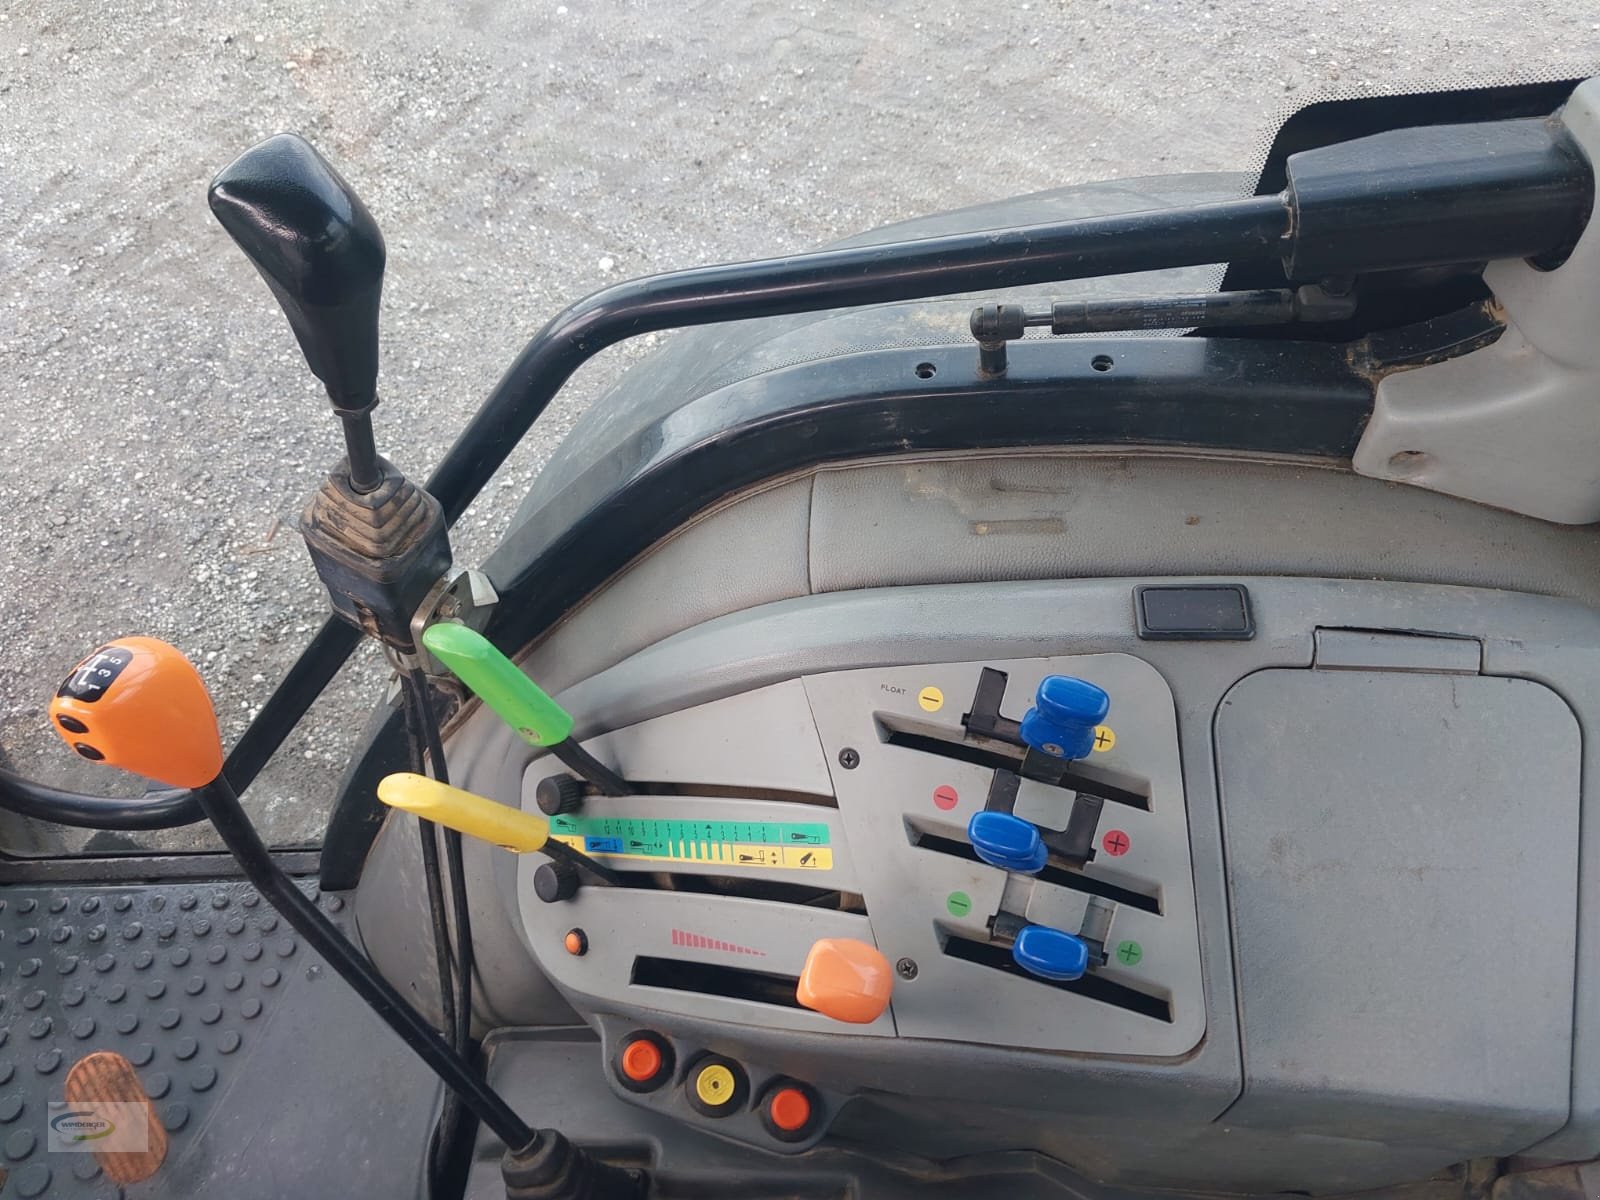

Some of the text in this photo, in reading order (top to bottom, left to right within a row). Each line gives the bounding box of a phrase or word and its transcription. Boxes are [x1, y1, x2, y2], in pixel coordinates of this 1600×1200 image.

[98, 668, 111, 677] 3
[109, 657, 122, 665] 5
[880, 683, 907, 695] FLOAT
